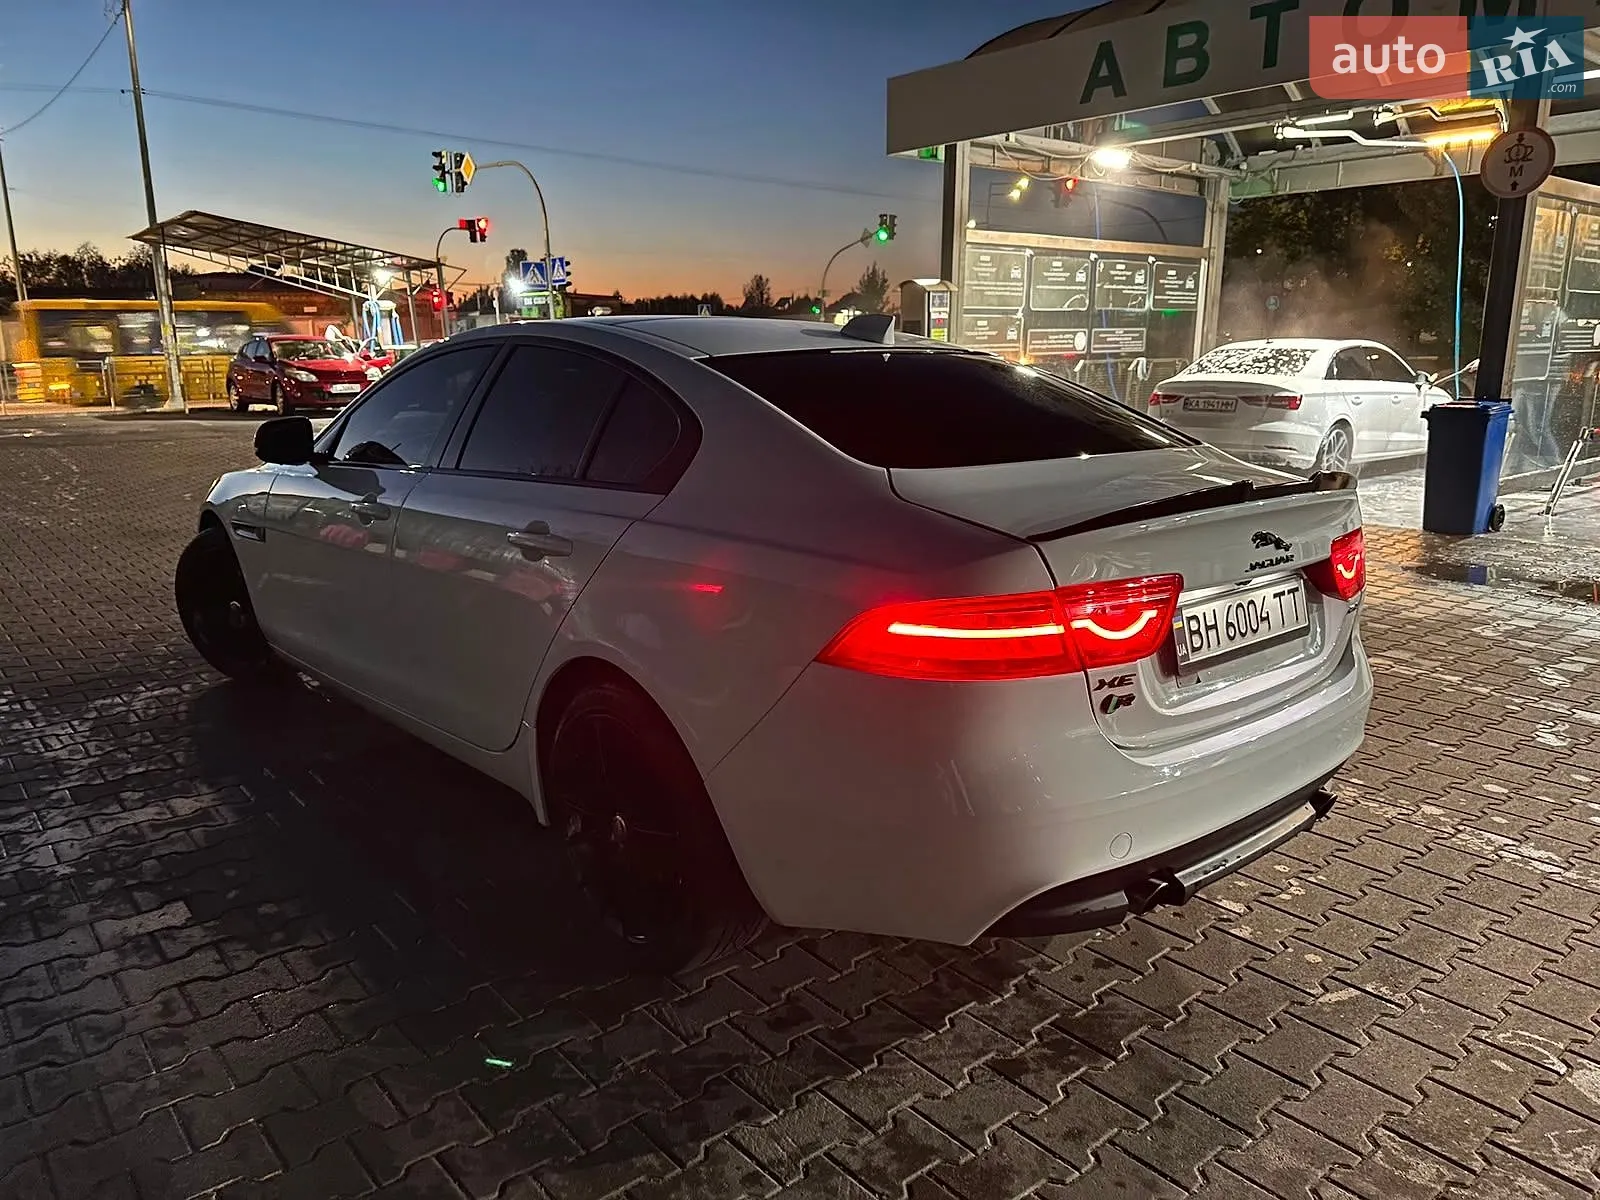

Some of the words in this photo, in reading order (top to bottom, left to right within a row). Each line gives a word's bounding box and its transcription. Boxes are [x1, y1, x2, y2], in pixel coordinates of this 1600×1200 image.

[1202, 399, 1219, 409] 1941
[1245, 554, 1295, 573] JAGUAR
[1186, 609, 1221, 653] BH
[1225, 595, 1272, 641] 6004
[1272, 587, 1299, 627] TT
[1177, 645, 1188, 657] UA
[1092, 673, 1136, 691] XE
